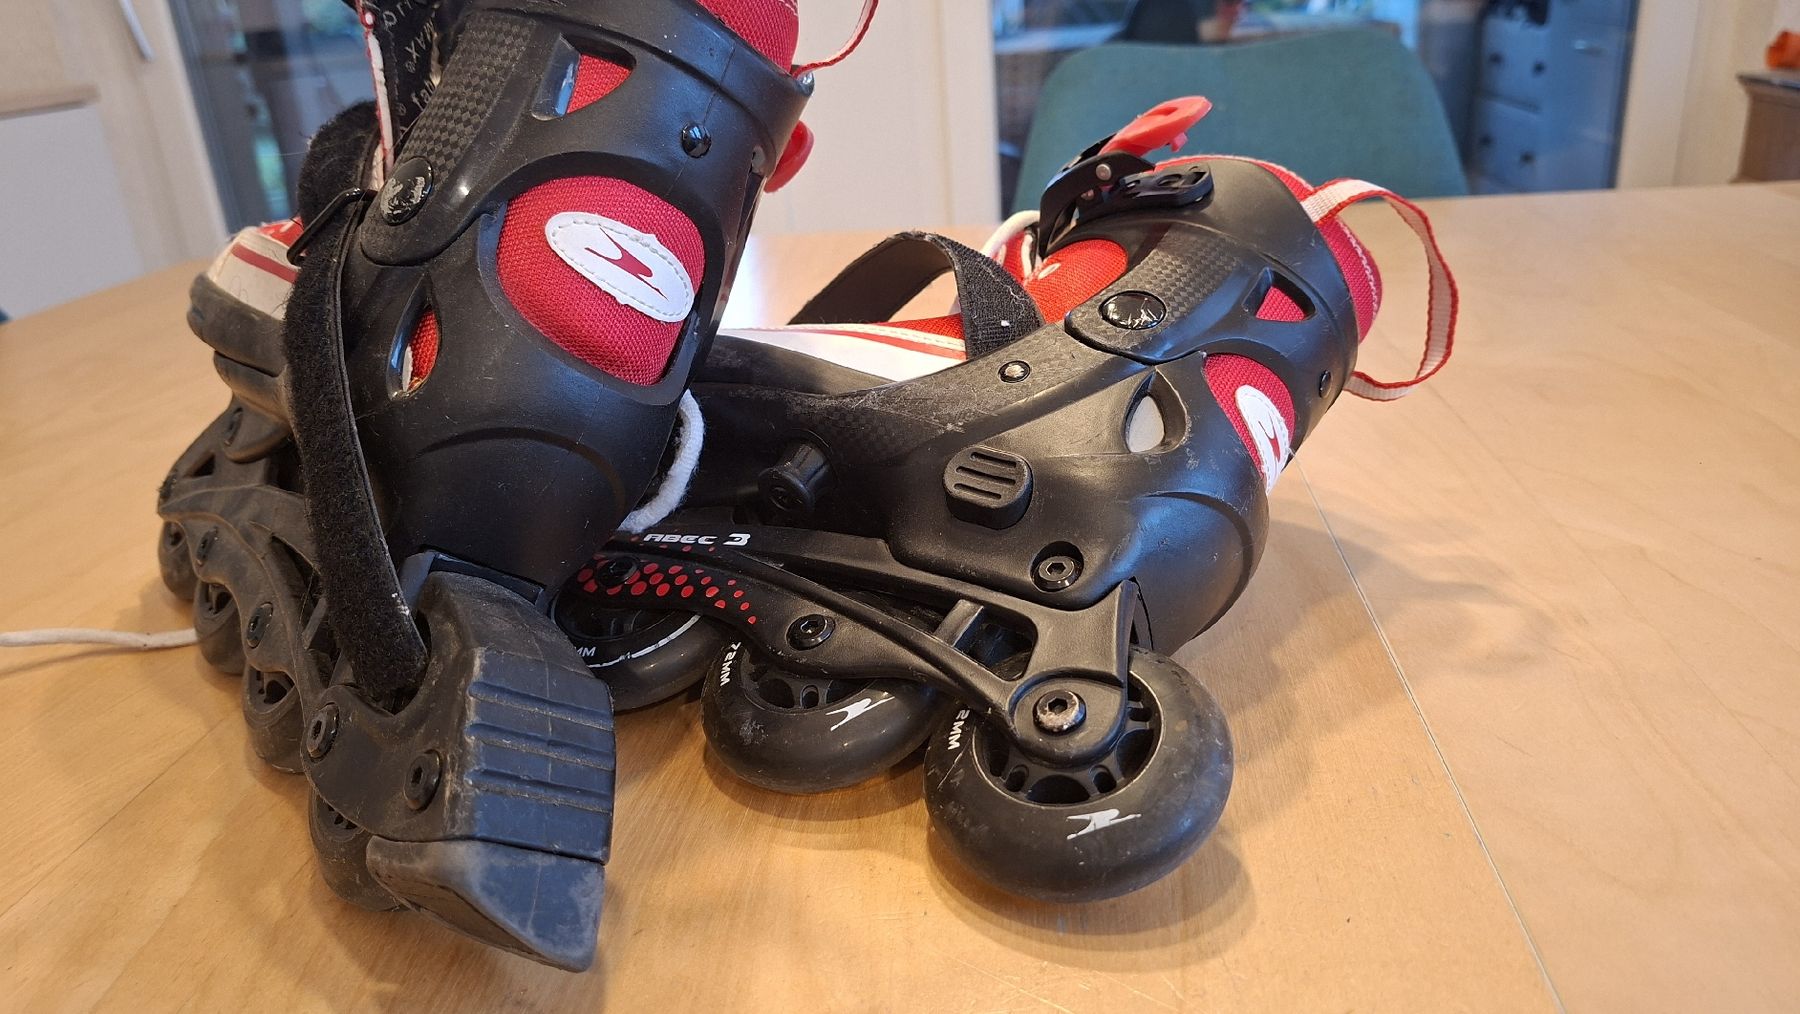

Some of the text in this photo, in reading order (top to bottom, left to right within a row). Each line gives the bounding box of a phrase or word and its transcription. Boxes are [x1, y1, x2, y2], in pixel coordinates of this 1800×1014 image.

[643, 533, 751, 546] ABEC 3
[719, 641, 741, 687] 72MM
